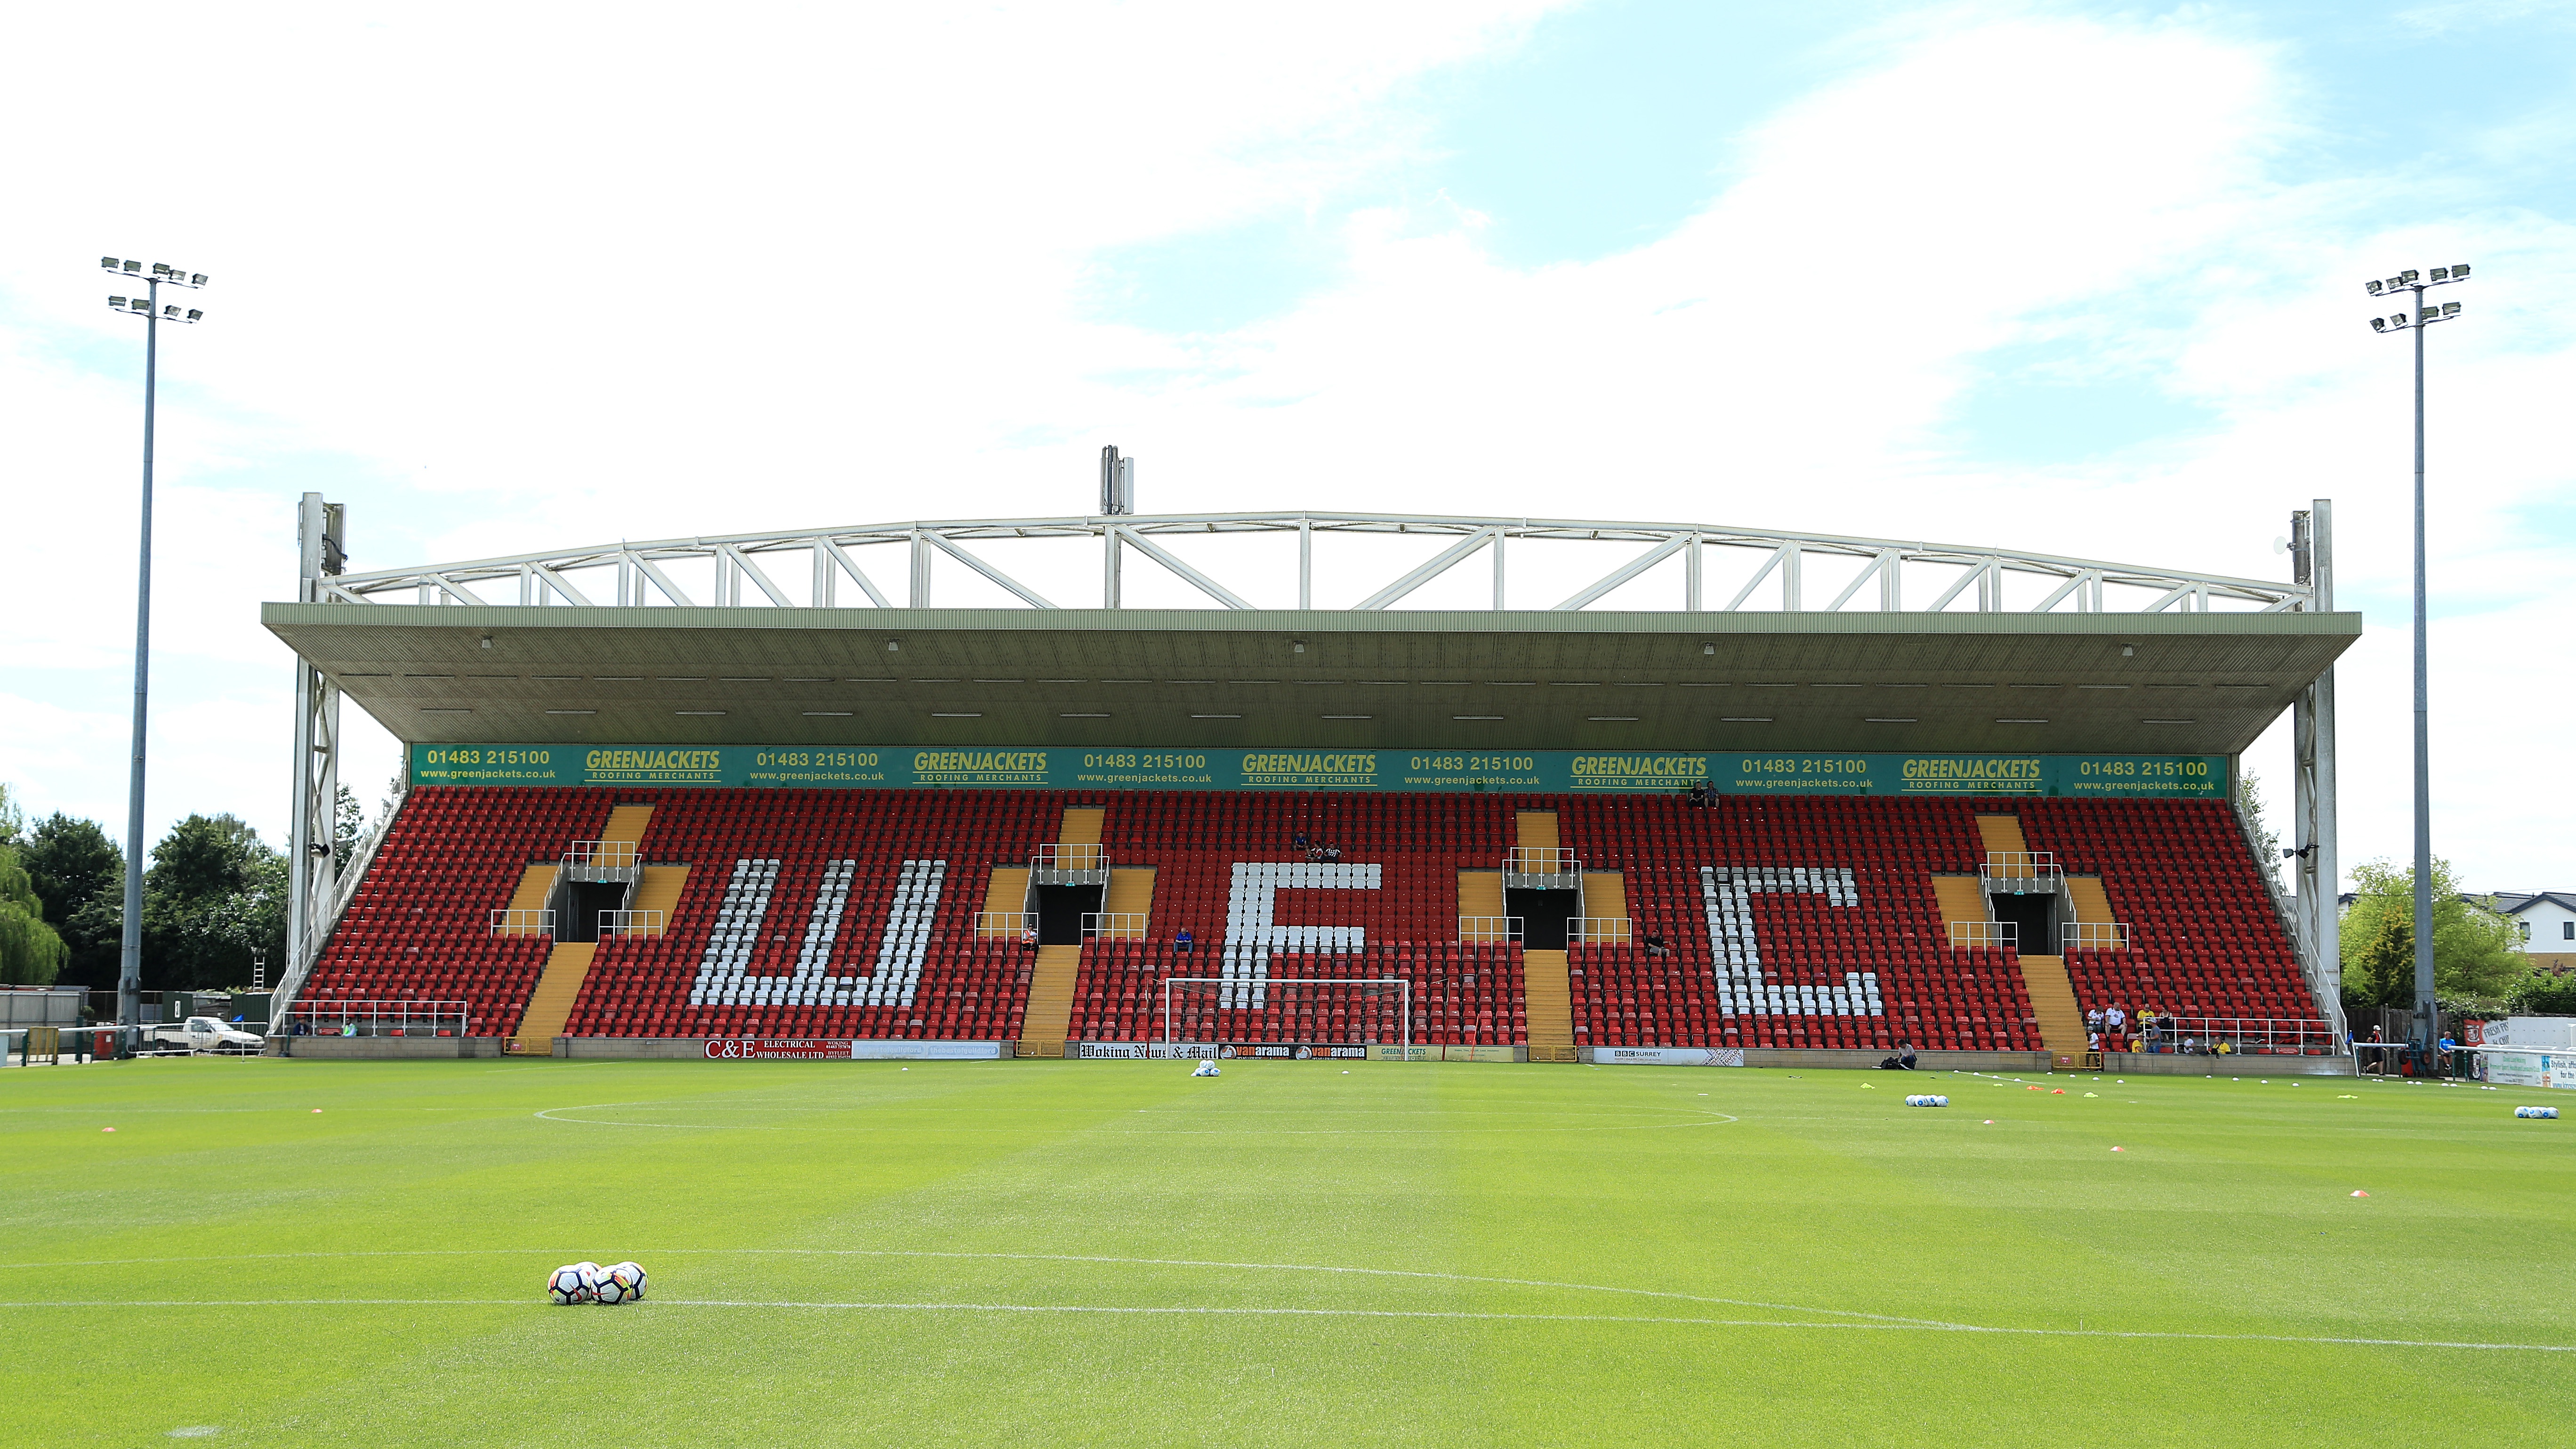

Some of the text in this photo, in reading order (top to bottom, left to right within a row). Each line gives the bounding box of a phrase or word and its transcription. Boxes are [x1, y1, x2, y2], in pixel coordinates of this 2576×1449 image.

[428, 750, 549, 764] 01483 215100
[587, 750, 719, 769] GREENJACKETS
[757, 753, 878, 766] 01483 215100
[915, 752, 1046, 770] GREENJACKETS
[1085, 754, 1205, 768] 01483 215100
[1243, 754, 1376, 773] GREENJACKETS
[1411, 757, 1533, 770] 01483 215100
[1572, 757, 1706, 776] GREENJACKETS
[1743, 759, 1867, 773] 01483 215100
[1903, 760, 2040, 778] GREENJACKETS
[2081, 762, 2207, 775] 01483 215100
[421, 770, 555, 779] www.greenjackets.co.uk
[750, 773, 884, 781] www.greenjackets.co.uk
[1078, 774, 1212, 783] www.greenjackets.co.uk
[1405, 776, 1539, 785] www.greenjackets.co.uk
[1736, 779, 1873, 788] www.greenjackets.co.uk
[2074, 781, 2214, 791] www.greenjackets.co.uk
[2484, 1025, 2501, 1038] FRESH
[705, 1040, 756, 1059] C&E
[1081, 1045, 1130, 1059] Woking
[1173, 1046, 1183, 1058] &
[1187, 1046, 1218, 1059] Mail
[1236, 1046, 1289, 1056] vanarama
[1312, 1046, 1365, 1057] vanarama
[2551, 1060, 2568, 1071] Stylish,
